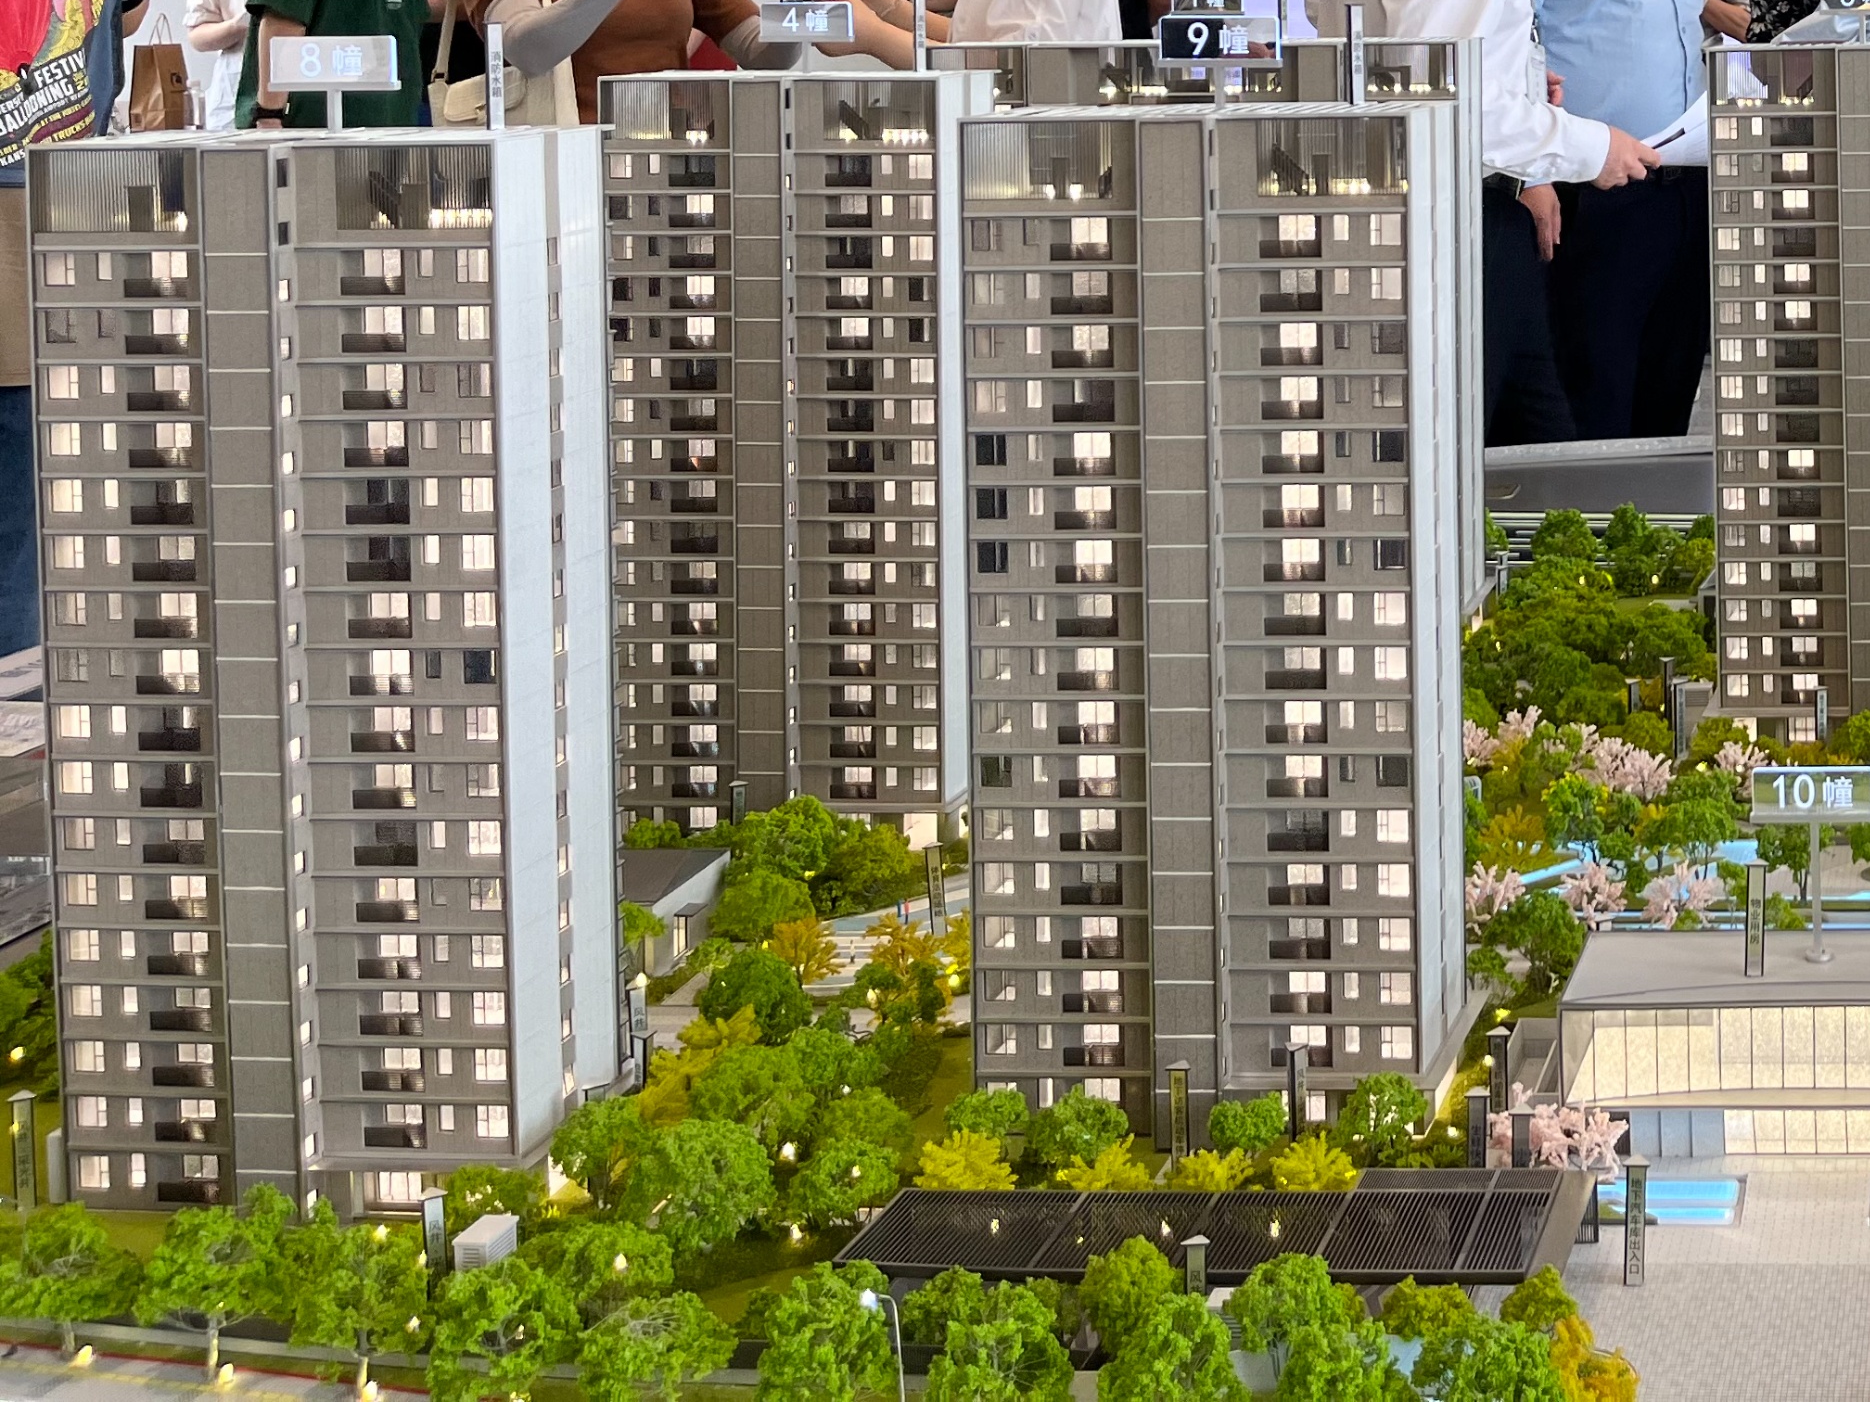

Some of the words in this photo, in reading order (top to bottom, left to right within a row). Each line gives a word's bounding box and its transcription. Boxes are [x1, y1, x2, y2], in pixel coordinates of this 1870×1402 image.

[782, 6, 829, 32] 4幢
[1187, 21, 1250, 56] 9幢
[300, 42, 363, 77] 8幢
[490, 50, 502, 98] 消防水箱
[1772, 773, 1854, 809] 10幢
[1750, 898, 1761, 945] 物业用房
[1628, 1176, 1642, 1275] 地下汽车库出入口
